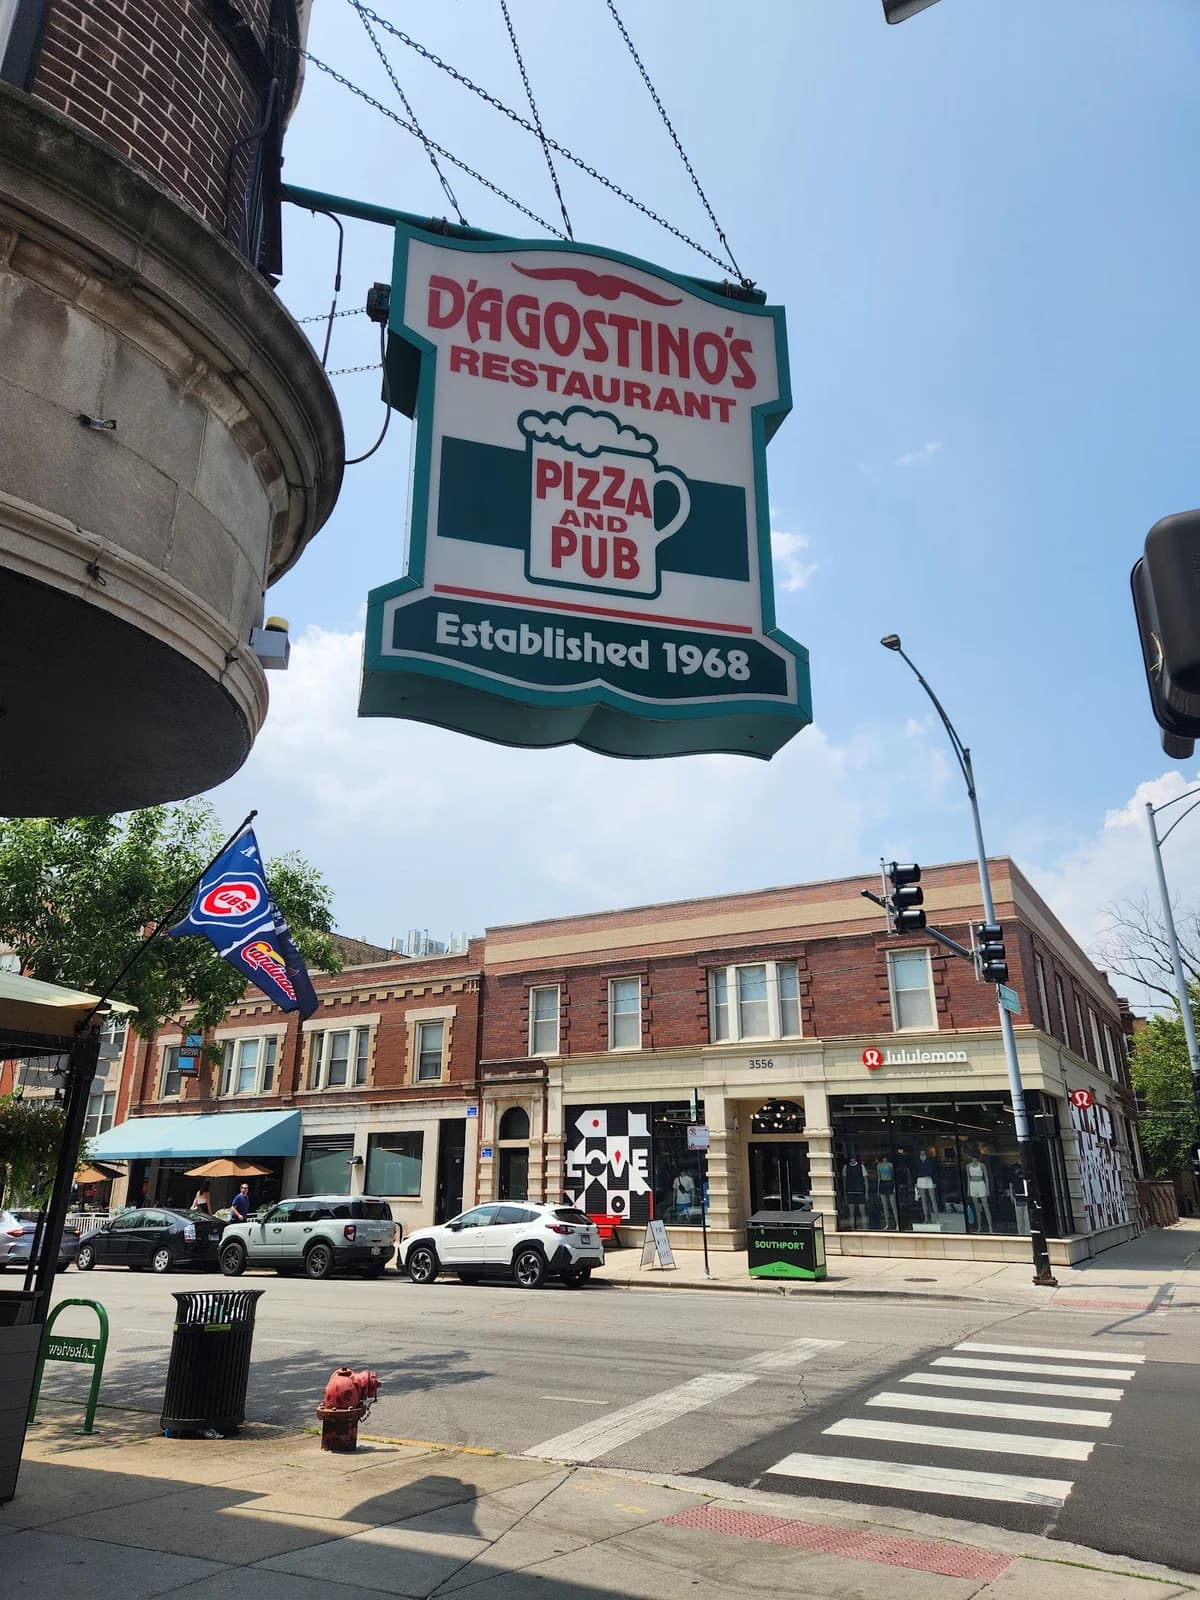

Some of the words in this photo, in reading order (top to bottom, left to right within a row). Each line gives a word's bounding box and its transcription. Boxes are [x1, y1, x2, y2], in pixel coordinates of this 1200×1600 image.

[427, 275, 755, 389] D'AGOSTINO'S
[449, 345, 737, 423] RESTAURANT
[536, 458, 653, 519] PIZZA
[558, 508, 628, 534] AND
[551, 526, 640, 580] PUB
[435, 611, 649, 671] Established
[660, 642, 752, 682] 1968
[749, 1059, 774, 1069] 3556
[886, 1049, 968, 1065] lululemon
[566, 1149, 649, 1178] LOVE
[754, 1240, 805, 1250] SOUTHPORT
